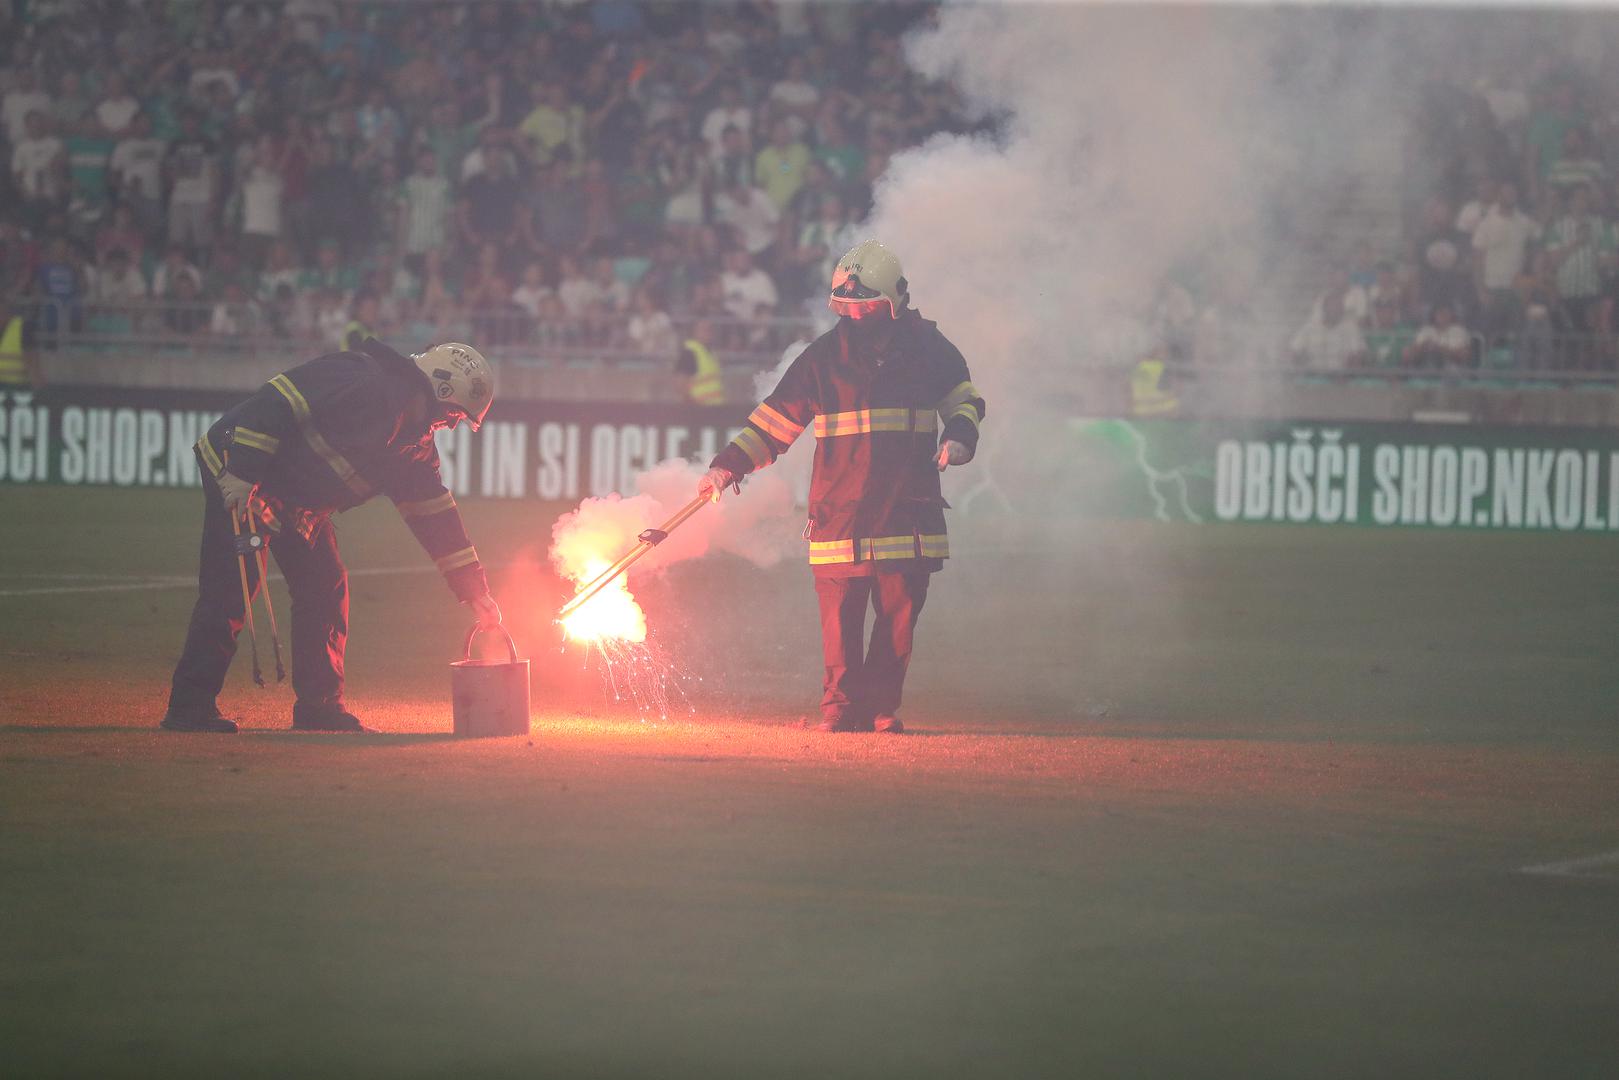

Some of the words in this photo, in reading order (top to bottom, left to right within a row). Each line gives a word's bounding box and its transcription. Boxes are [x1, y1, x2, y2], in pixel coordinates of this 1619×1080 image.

[0, 391, 49, 481] ČI
[481, 421, 528, 498] IN
[537, 422, 580, 499] SI
[1214, 429, 1360, 524] OBIŠČI
